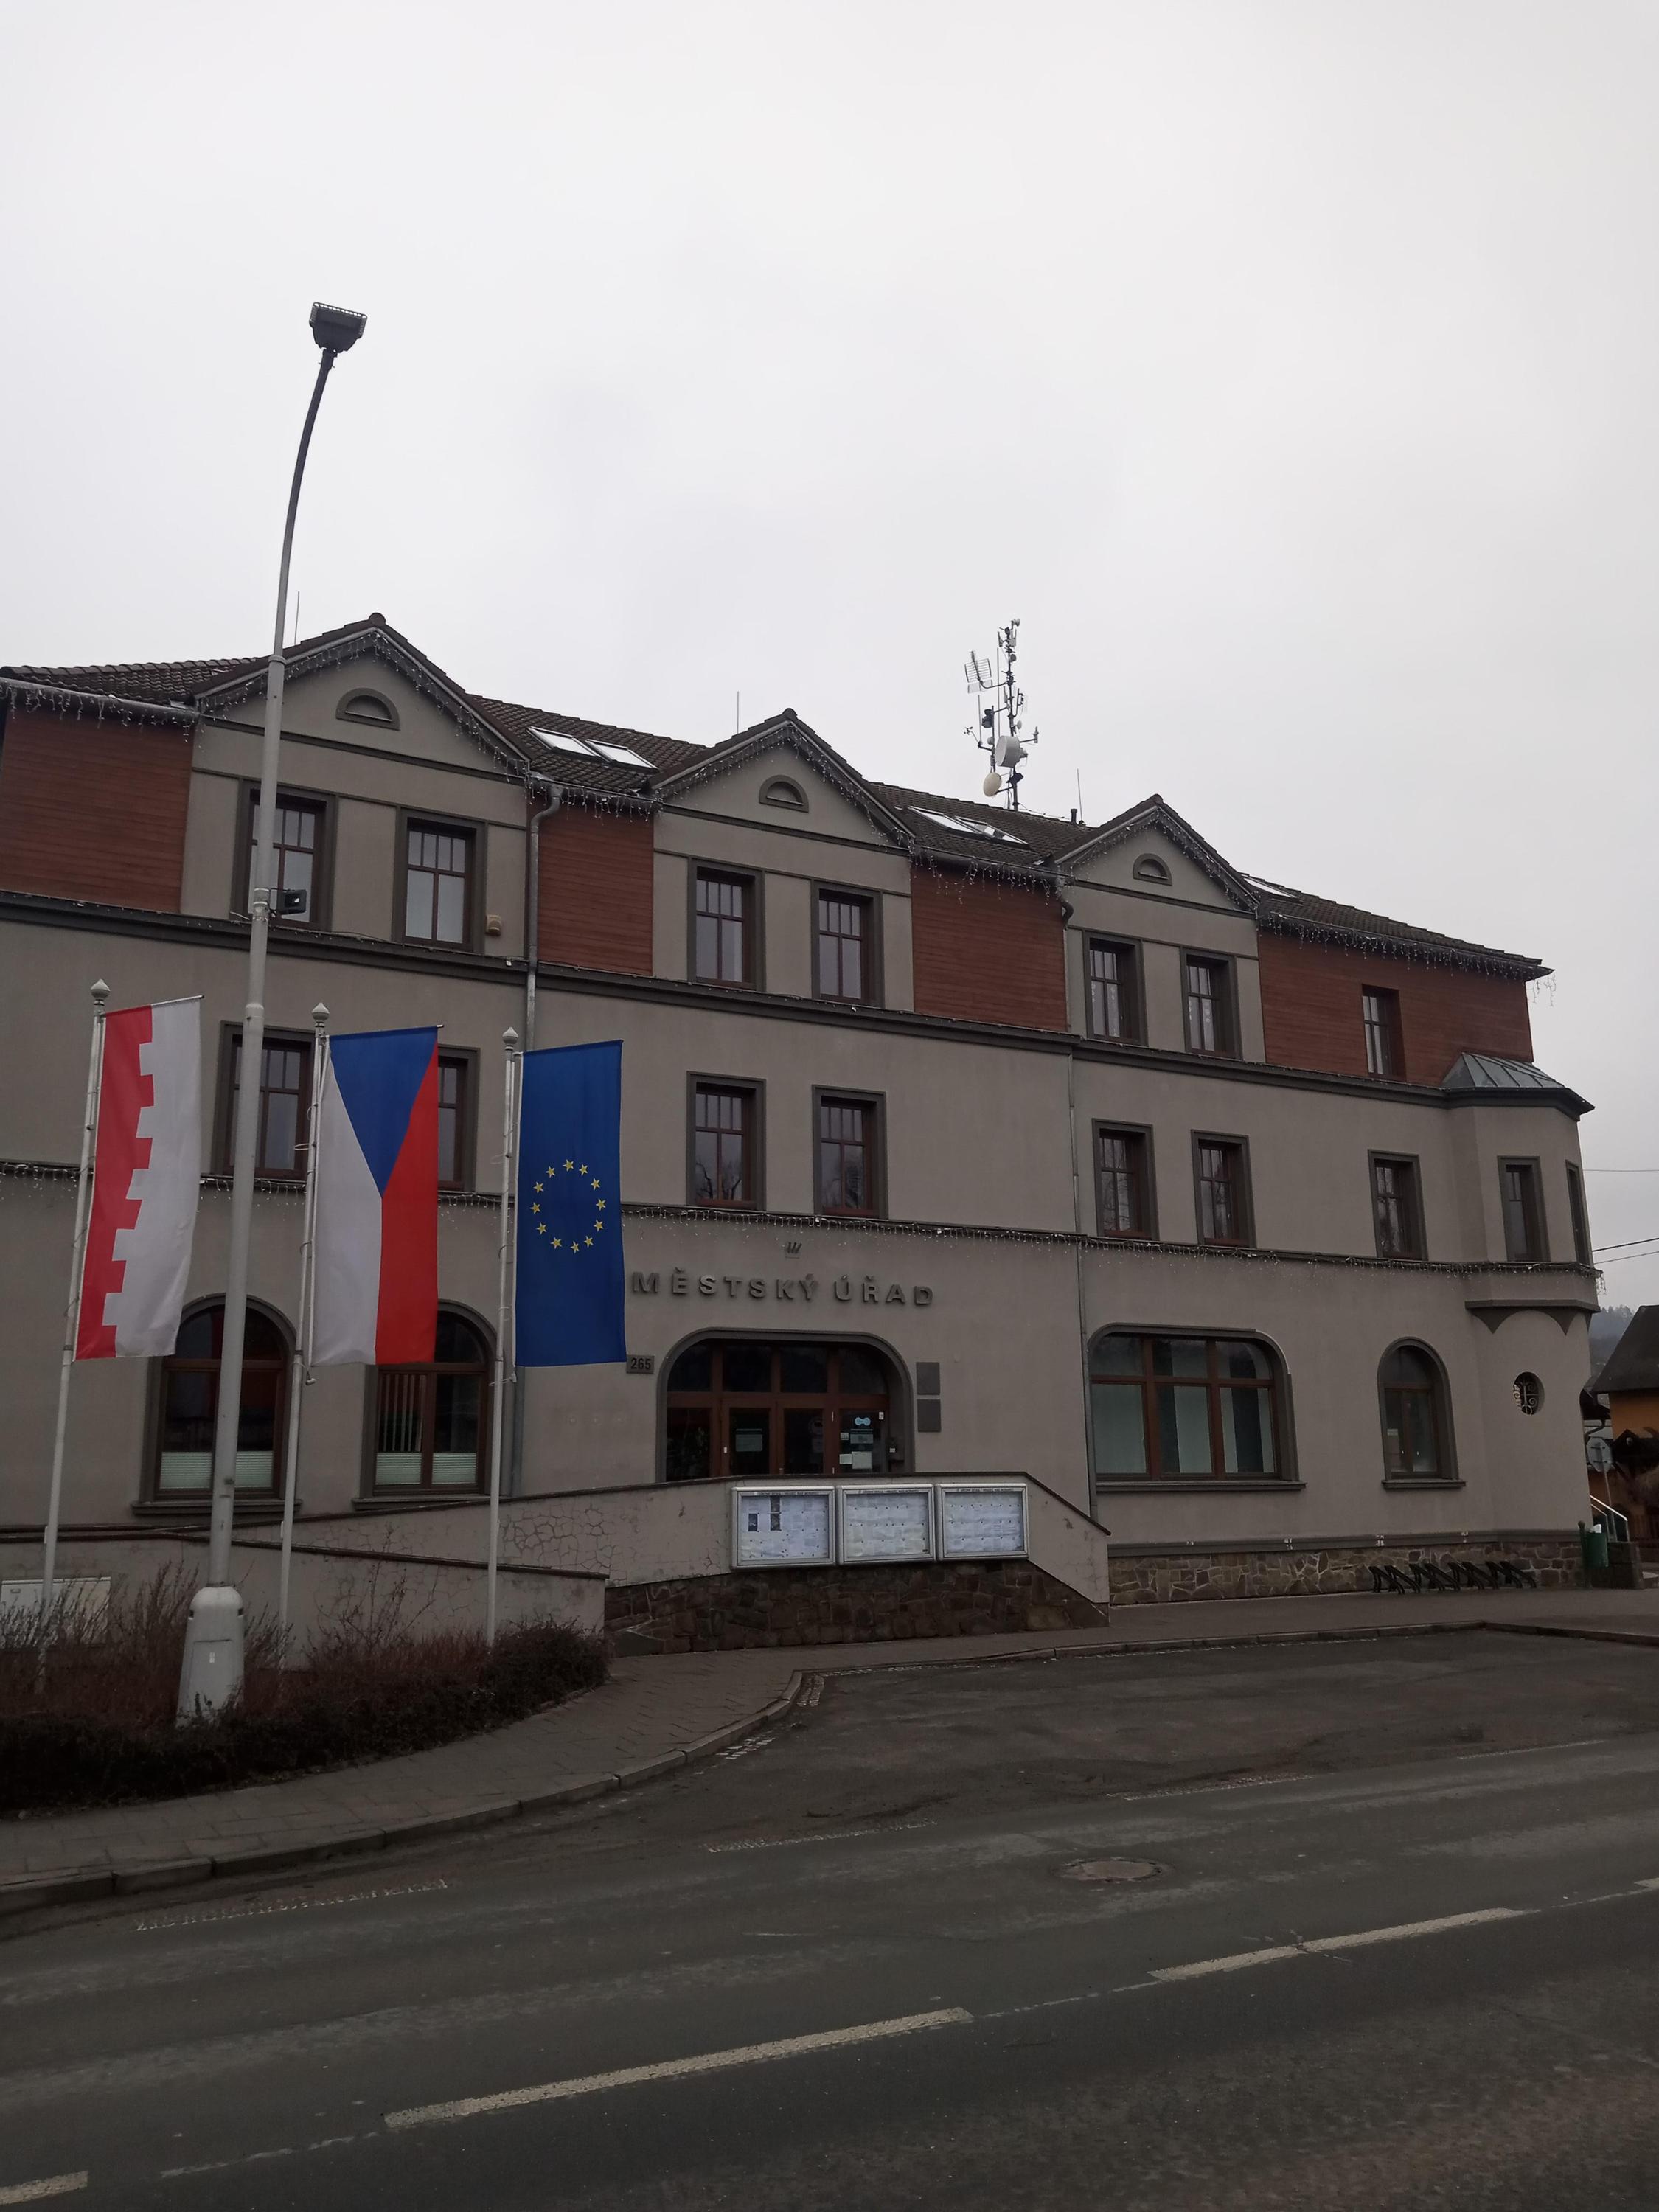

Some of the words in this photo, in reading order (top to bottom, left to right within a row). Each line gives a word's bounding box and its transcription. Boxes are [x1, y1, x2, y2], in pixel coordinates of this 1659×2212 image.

[632, 1267, 818, 1300] MĚSTSKÝ
[834, 1274, 933, 1305] ÚŘAD
[630, 1357, 651, 1369] 265
